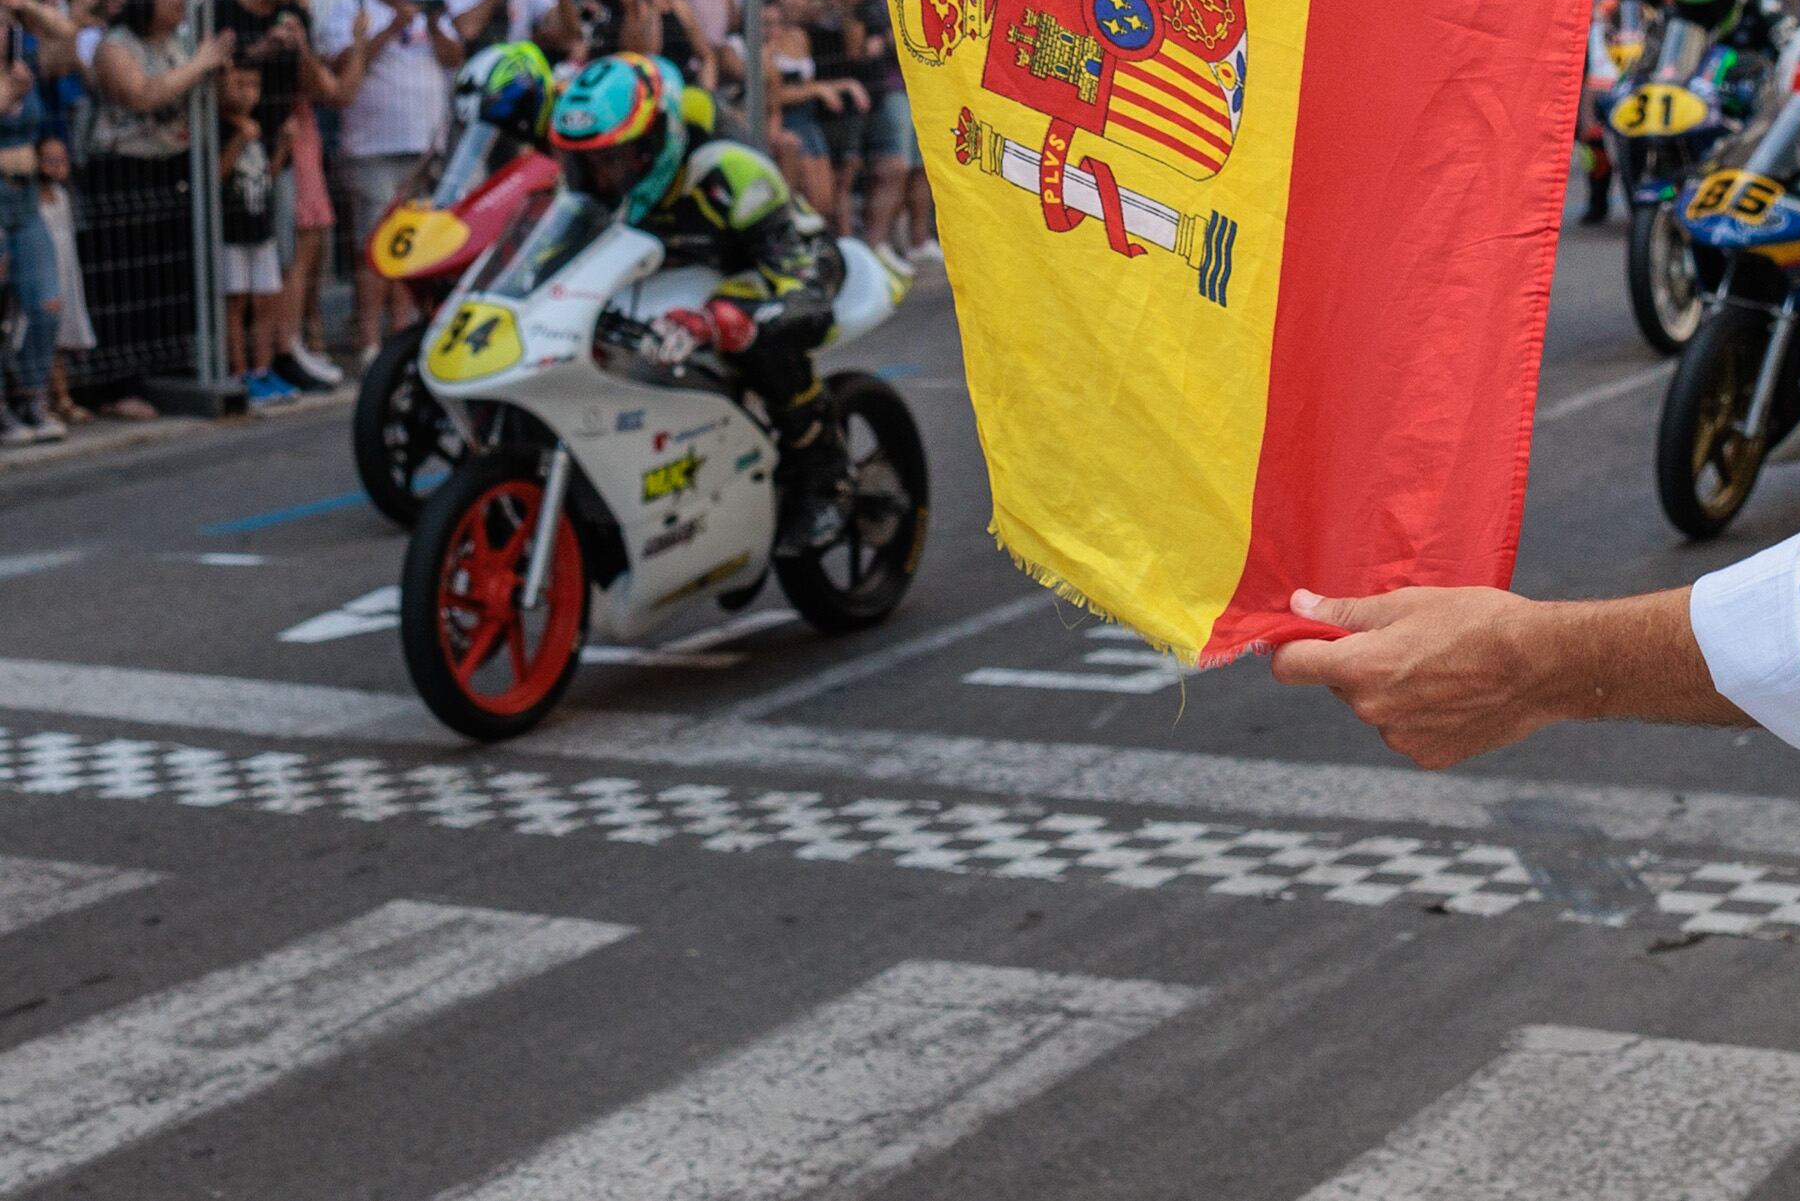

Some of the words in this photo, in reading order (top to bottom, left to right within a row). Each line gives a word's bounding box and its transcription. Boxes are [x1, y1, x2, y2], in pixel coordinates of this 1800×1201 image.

[1628, 94, 1674, 128] 31
[1044, 133, 1066, 204] PLVS
[390, 224, 416, 260] 6
